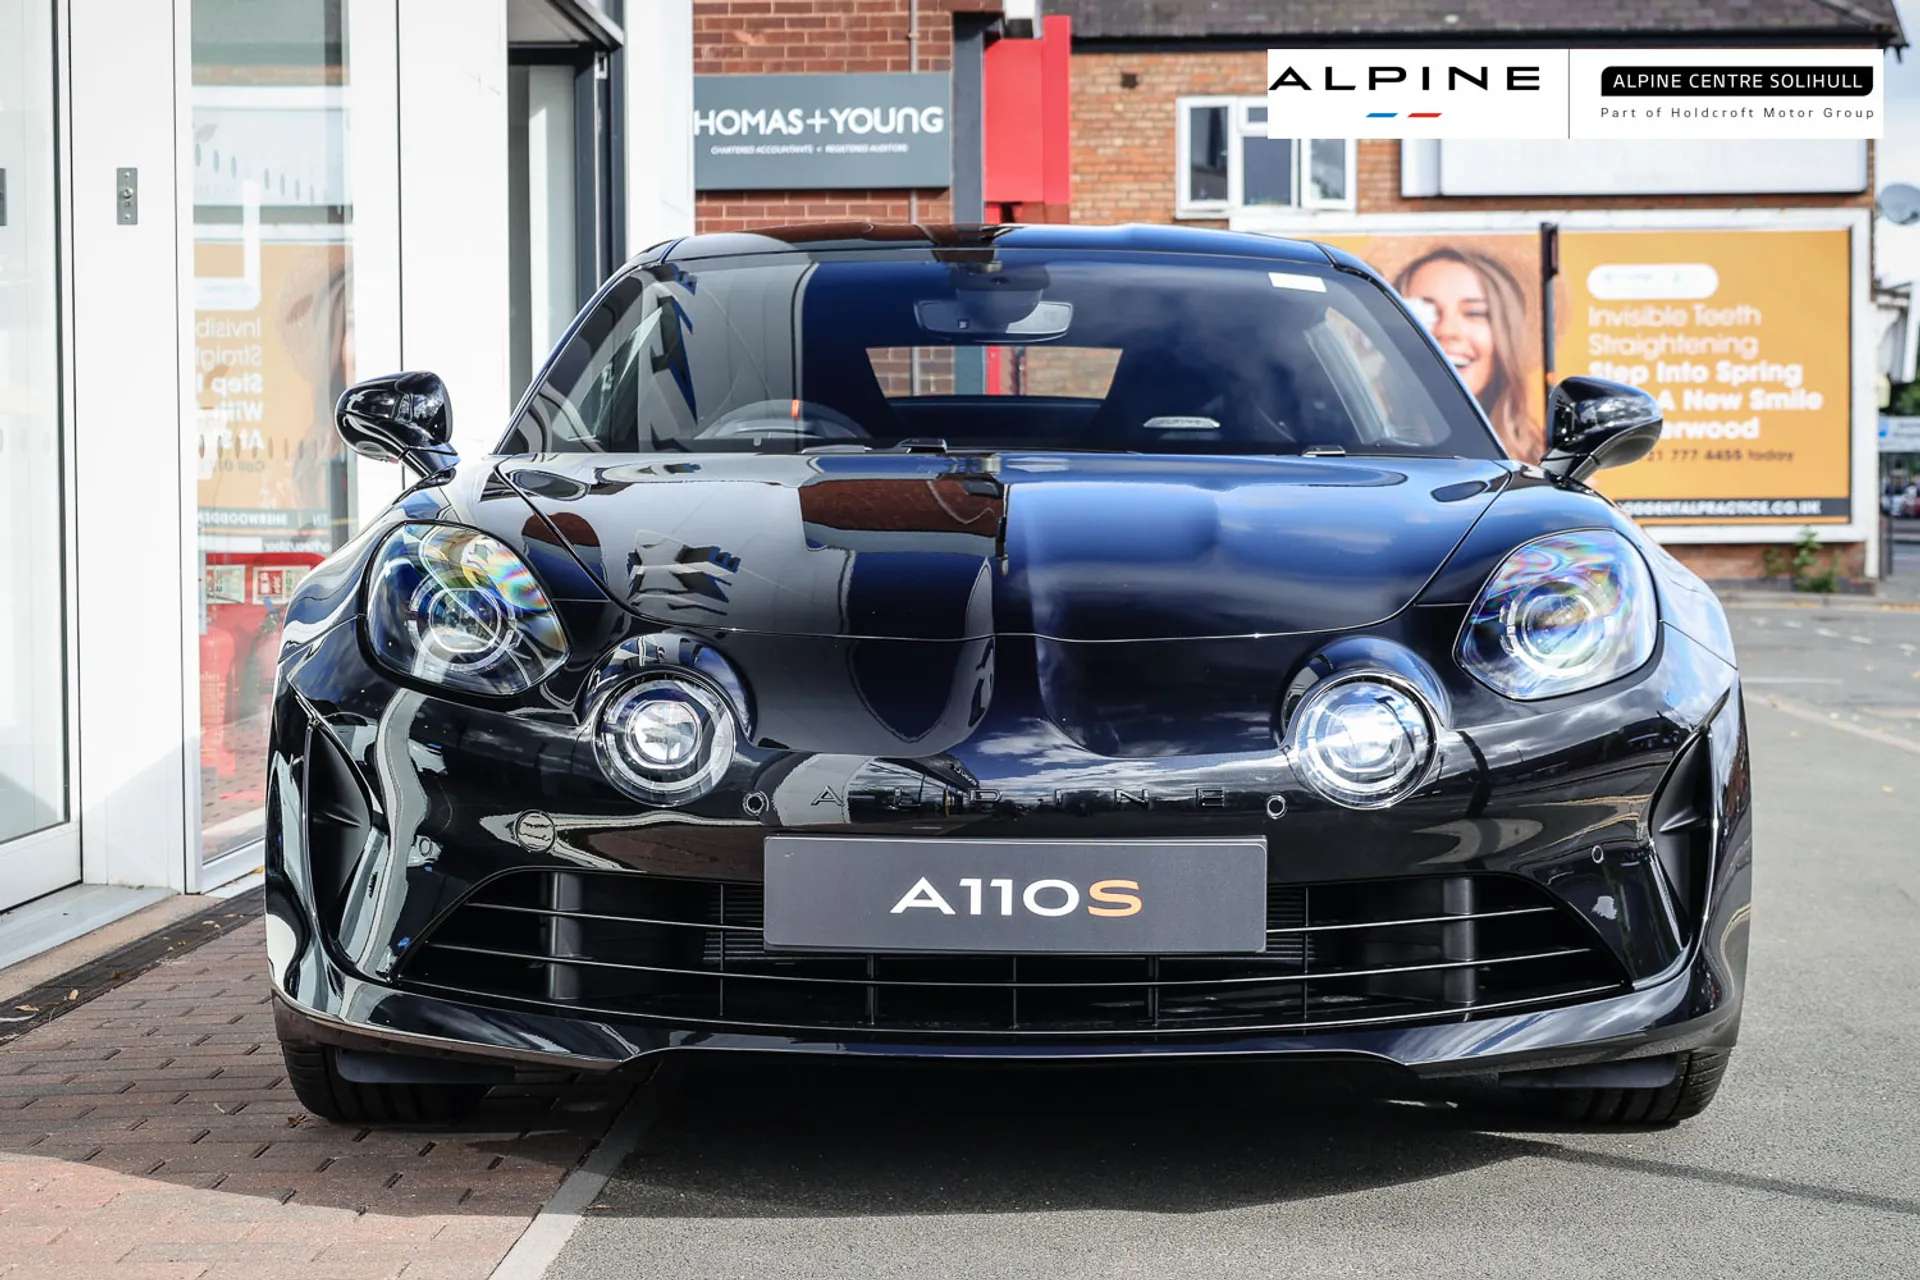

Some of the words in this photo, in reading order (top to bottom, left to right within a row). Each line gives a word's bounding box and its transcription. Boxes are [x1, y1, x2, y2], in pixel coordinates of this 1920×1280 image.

[1588, 304, 1688, 327] Invisible
[1693, 303, 1762, 326] Teeth
[1588, 332, 1760, 361] Straightening
[1588, 361, 1649, 386] Step
[1656, 361, 1710, 384] Into
[1715, 360, 1804, 388] Spring
[1656, 389, 1676, 411] A
[1683, 389, 1743, 411] New
[1750, 388, 1824, 411] Smile
[1671, 449, 1698, 462] 777
[810, 785, 1226, 809] ALPINE
[889, 876, 1144, 917] A110S
